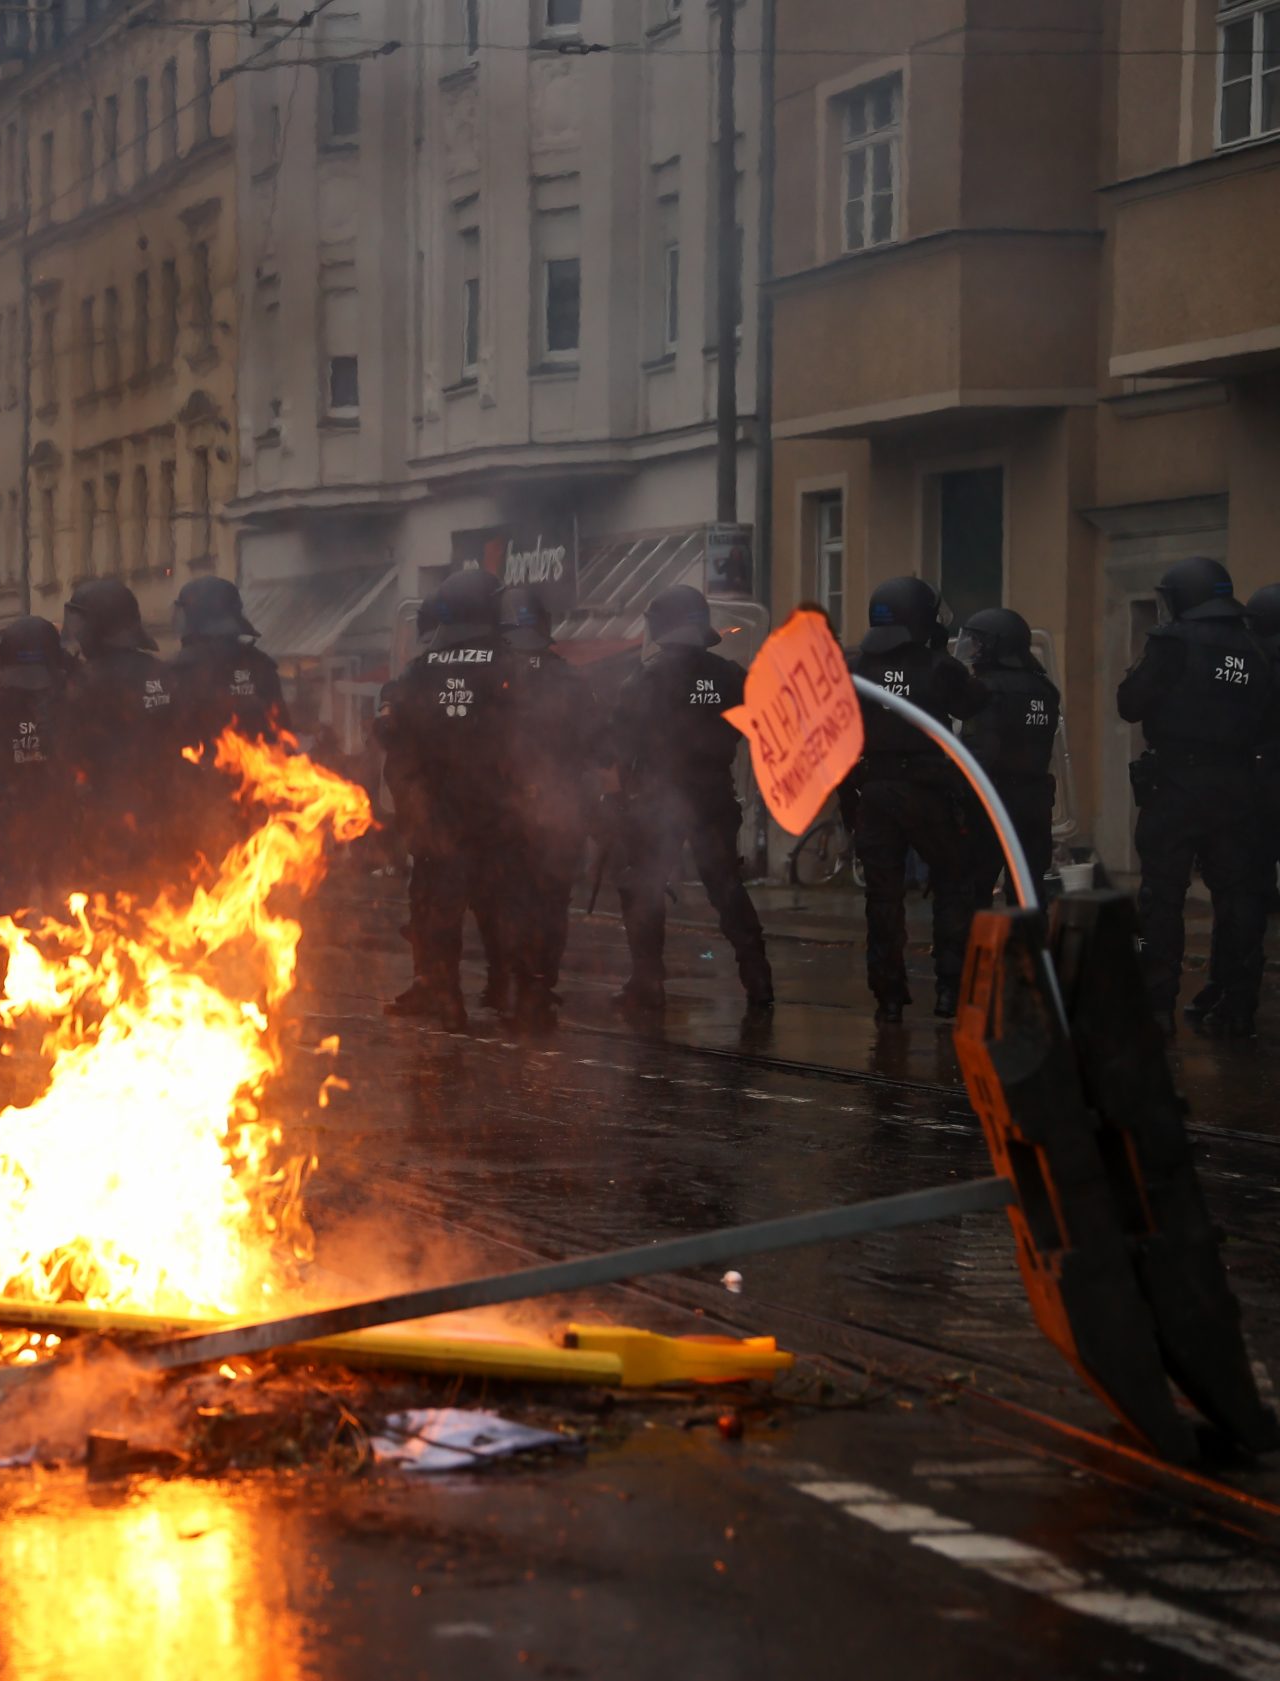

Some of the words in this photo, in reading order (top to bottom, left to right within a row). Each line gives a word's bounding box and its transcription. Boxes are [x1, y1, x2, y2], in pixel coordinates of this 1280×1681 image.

[504, 533, 566, 587] borders
[427, 648, 493, 664] POLIZEI
[1225, 656, 1244, 670] SN
[883, 671, 904, 684] SN
[1215, 667, 1249, 685] 21/21
[446, 677, 465, 690] SN
[695, 679, 714, 691] SN
[689, 691, 722, 705] 21/23
[1030, 699, 1044, 712] SN
[1025, 712, 1049, 726] 21/21
